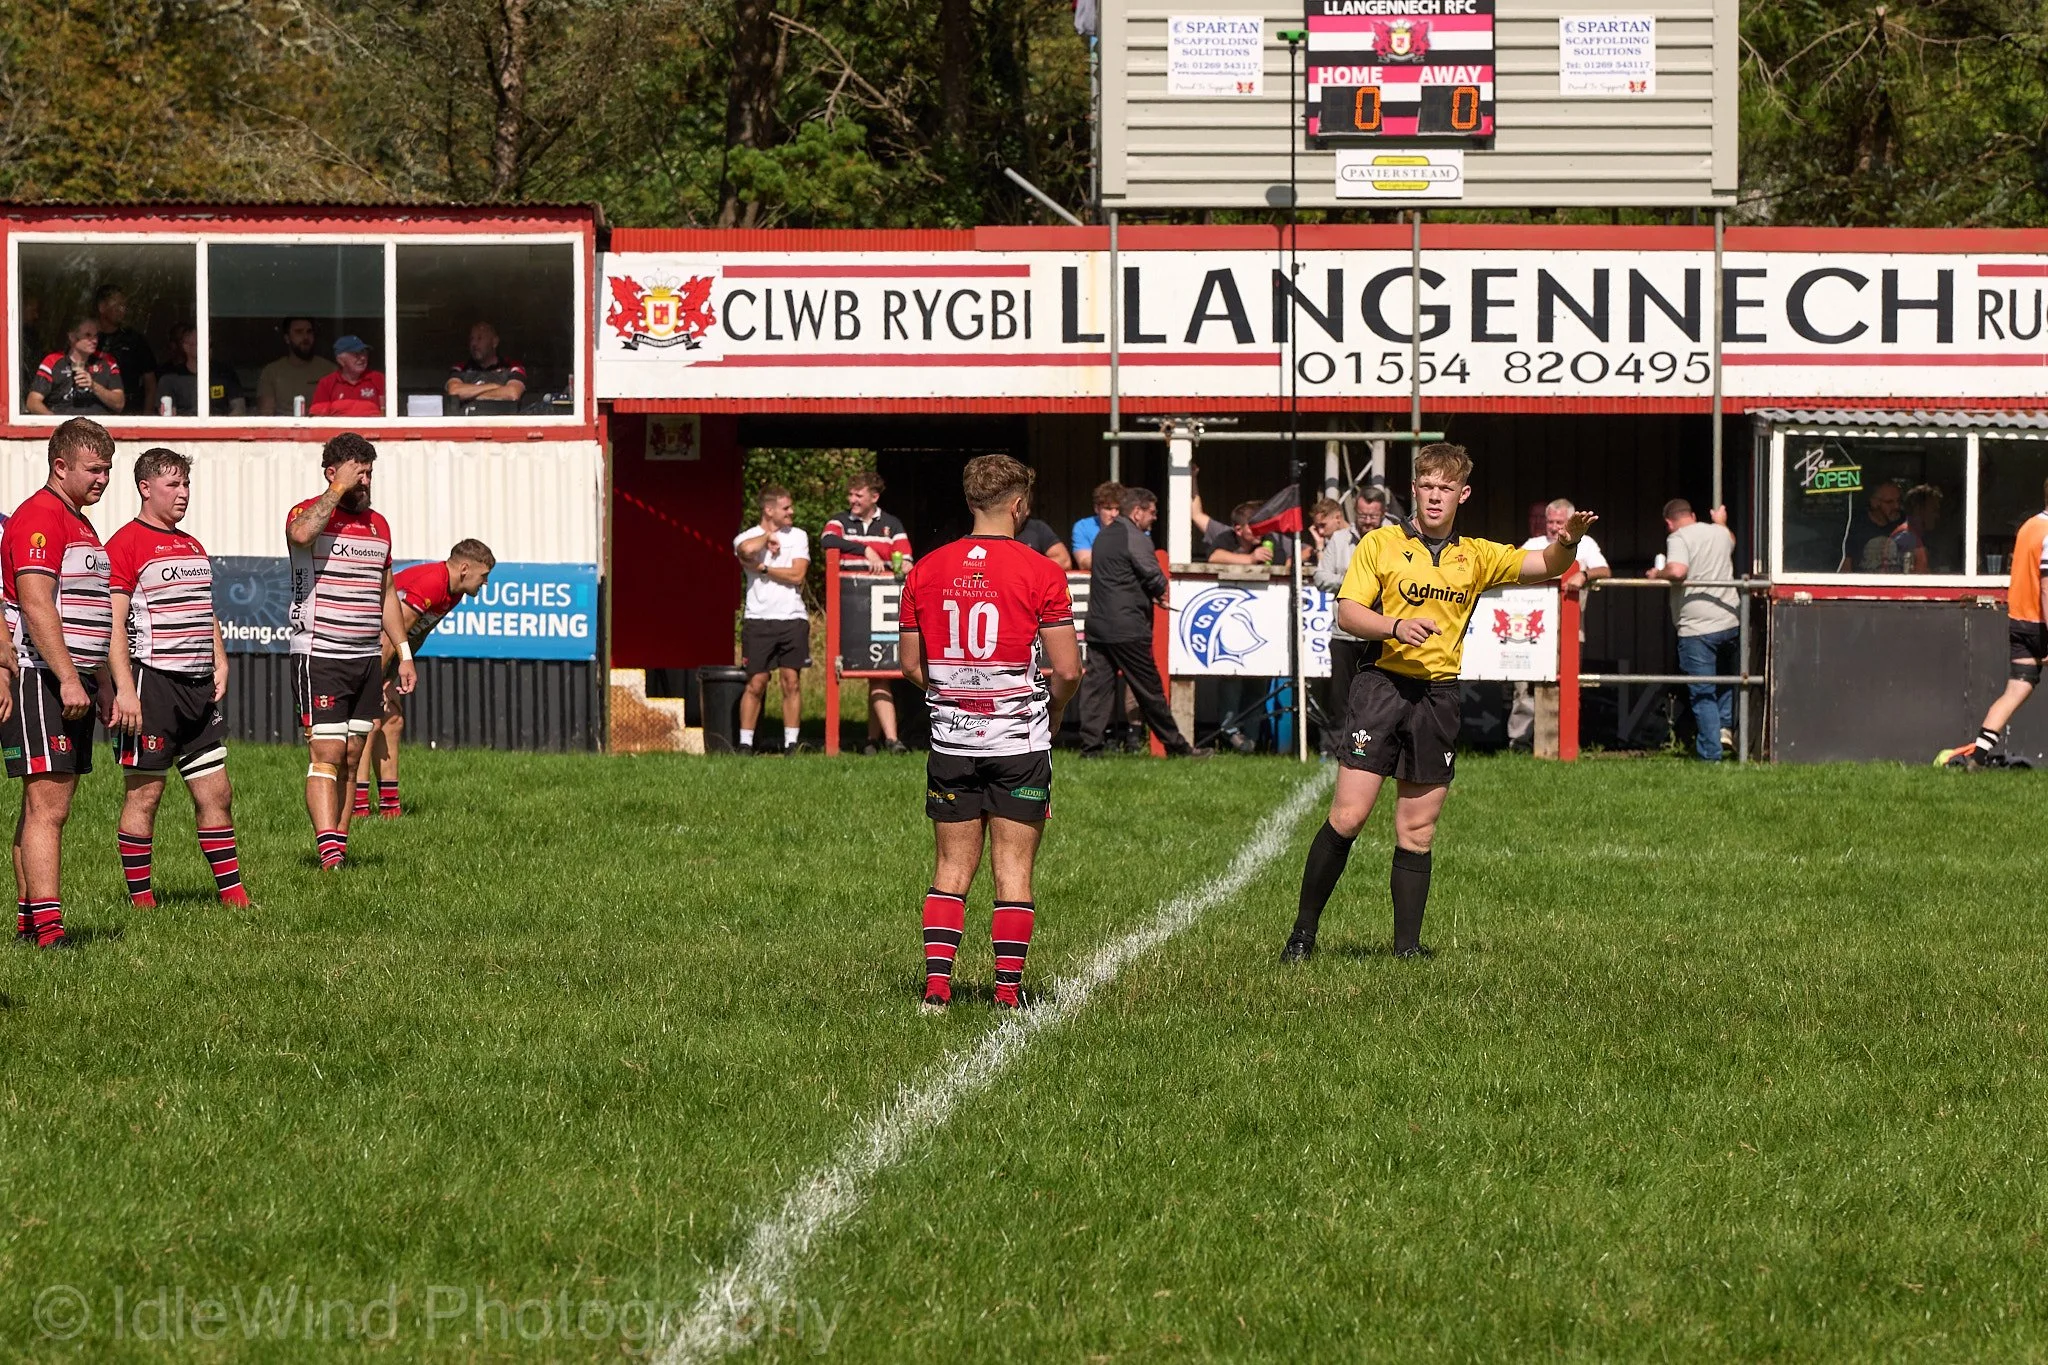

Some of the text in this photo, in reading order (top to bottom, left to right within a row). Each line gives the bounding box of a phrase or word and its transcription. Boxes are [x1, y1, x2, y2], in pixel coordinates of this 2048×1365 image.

[1323, 0, 1477, 15] LLANGENNECH RFC
[1186, 21, 1259, 34] SPARTAN
[1577, 21, 1651, 33] SPARTAN
[1174, 37, 1258, 46] SCAFFOLDING
[1565, 37, 1649, 45] SCAFFOLDING
[1182, 48, 1250, 56] SOLUTIONS
[1573, 48, 1642, 56] SOLUTIONS
[1317, 65, 1482, 84] HOME AWAY
[1354, 86, 1479, 130] 0 0
[1350, 169, 1450, 178] PAVIERSTEAM
[723, 266, 2048, 344] CLWB RYGBI LLANGENNECH RU
[1297, 350, 1711, 384] 01554 820495
[1794, 448, 1834, 487] Bar
[1814, 471, 1860, 489] OPEN
[29, 548, 46, 559] FEI
[331, 543, 386, 559] CK foodstores
[161, 567, 212, 581] CK foodstor
[953, 577, 990, 589] CELTIC
[291, 568, 303, 620] EMERGE
[962, 590, 984, 598] PASTY
[1407, 582, 1469, 605] Admiral
[942, 599, 1000, 660] 10
